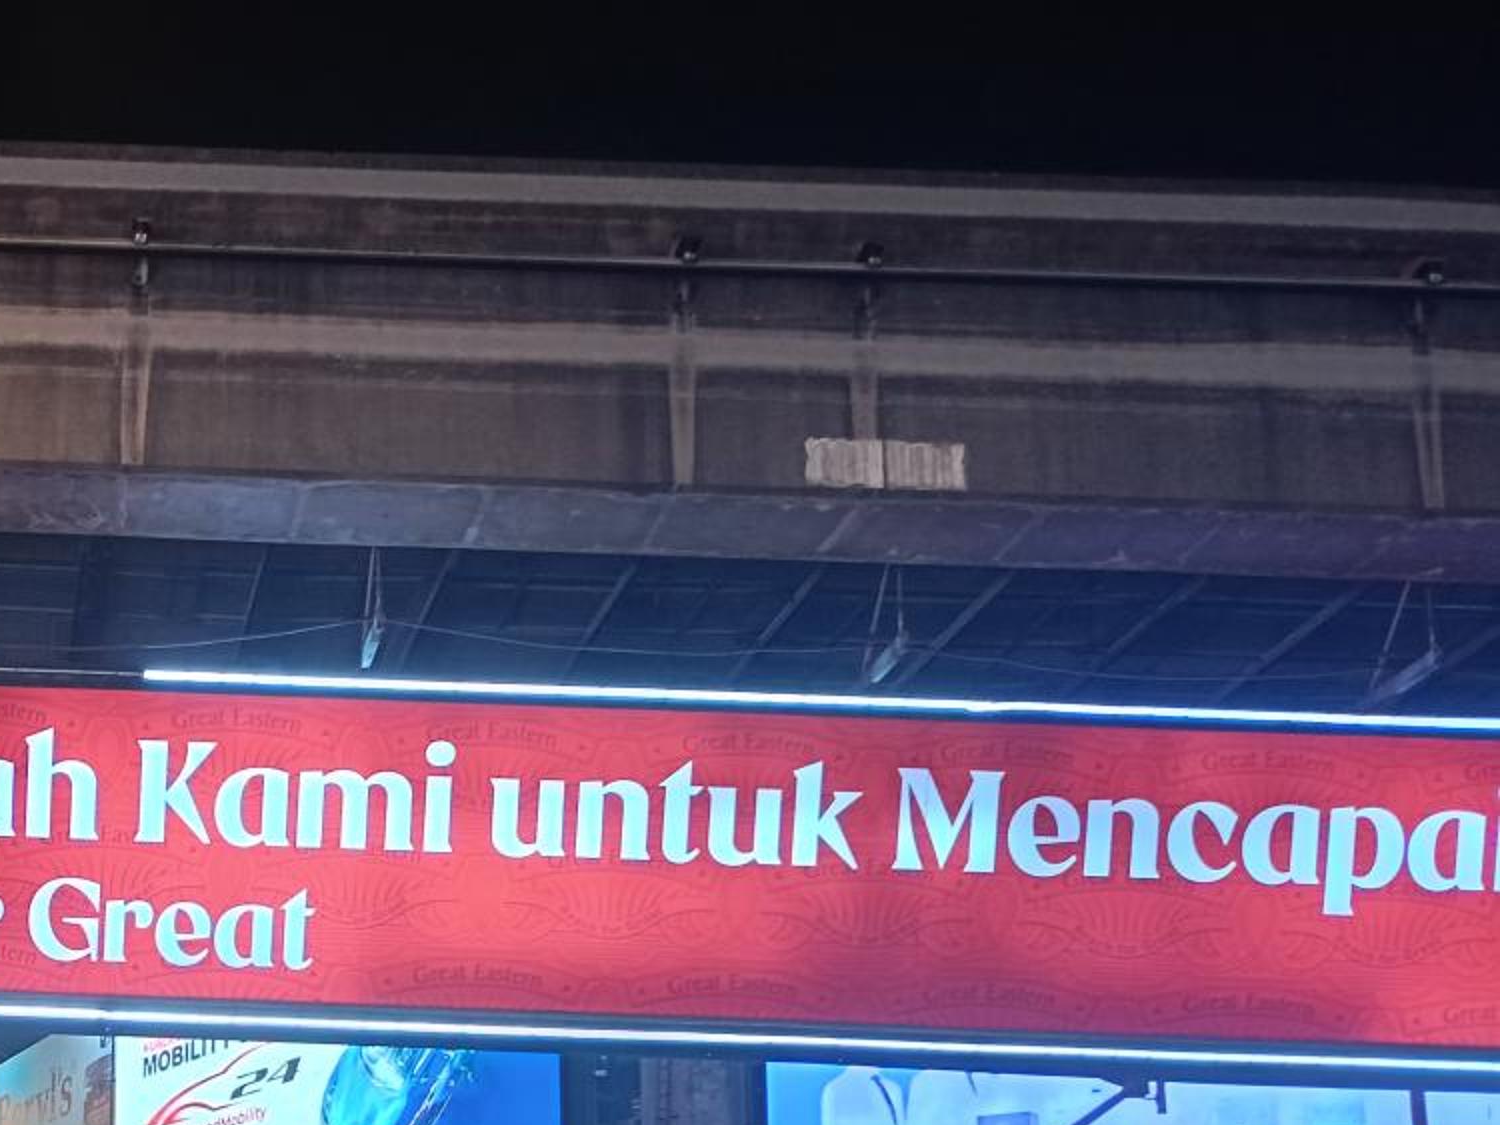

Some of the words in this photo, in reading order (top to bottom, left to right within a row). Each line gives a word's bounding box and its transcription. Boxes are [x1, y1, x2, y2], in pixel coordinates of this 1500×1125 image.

[135, 740, 456, 852] Kami
[491, 761, 862, 869] untuk
[892, 768, 1500, 915] Mencapa
[29, 878, 315, 970] Great
[230, 1057, 301, 1100] 24
